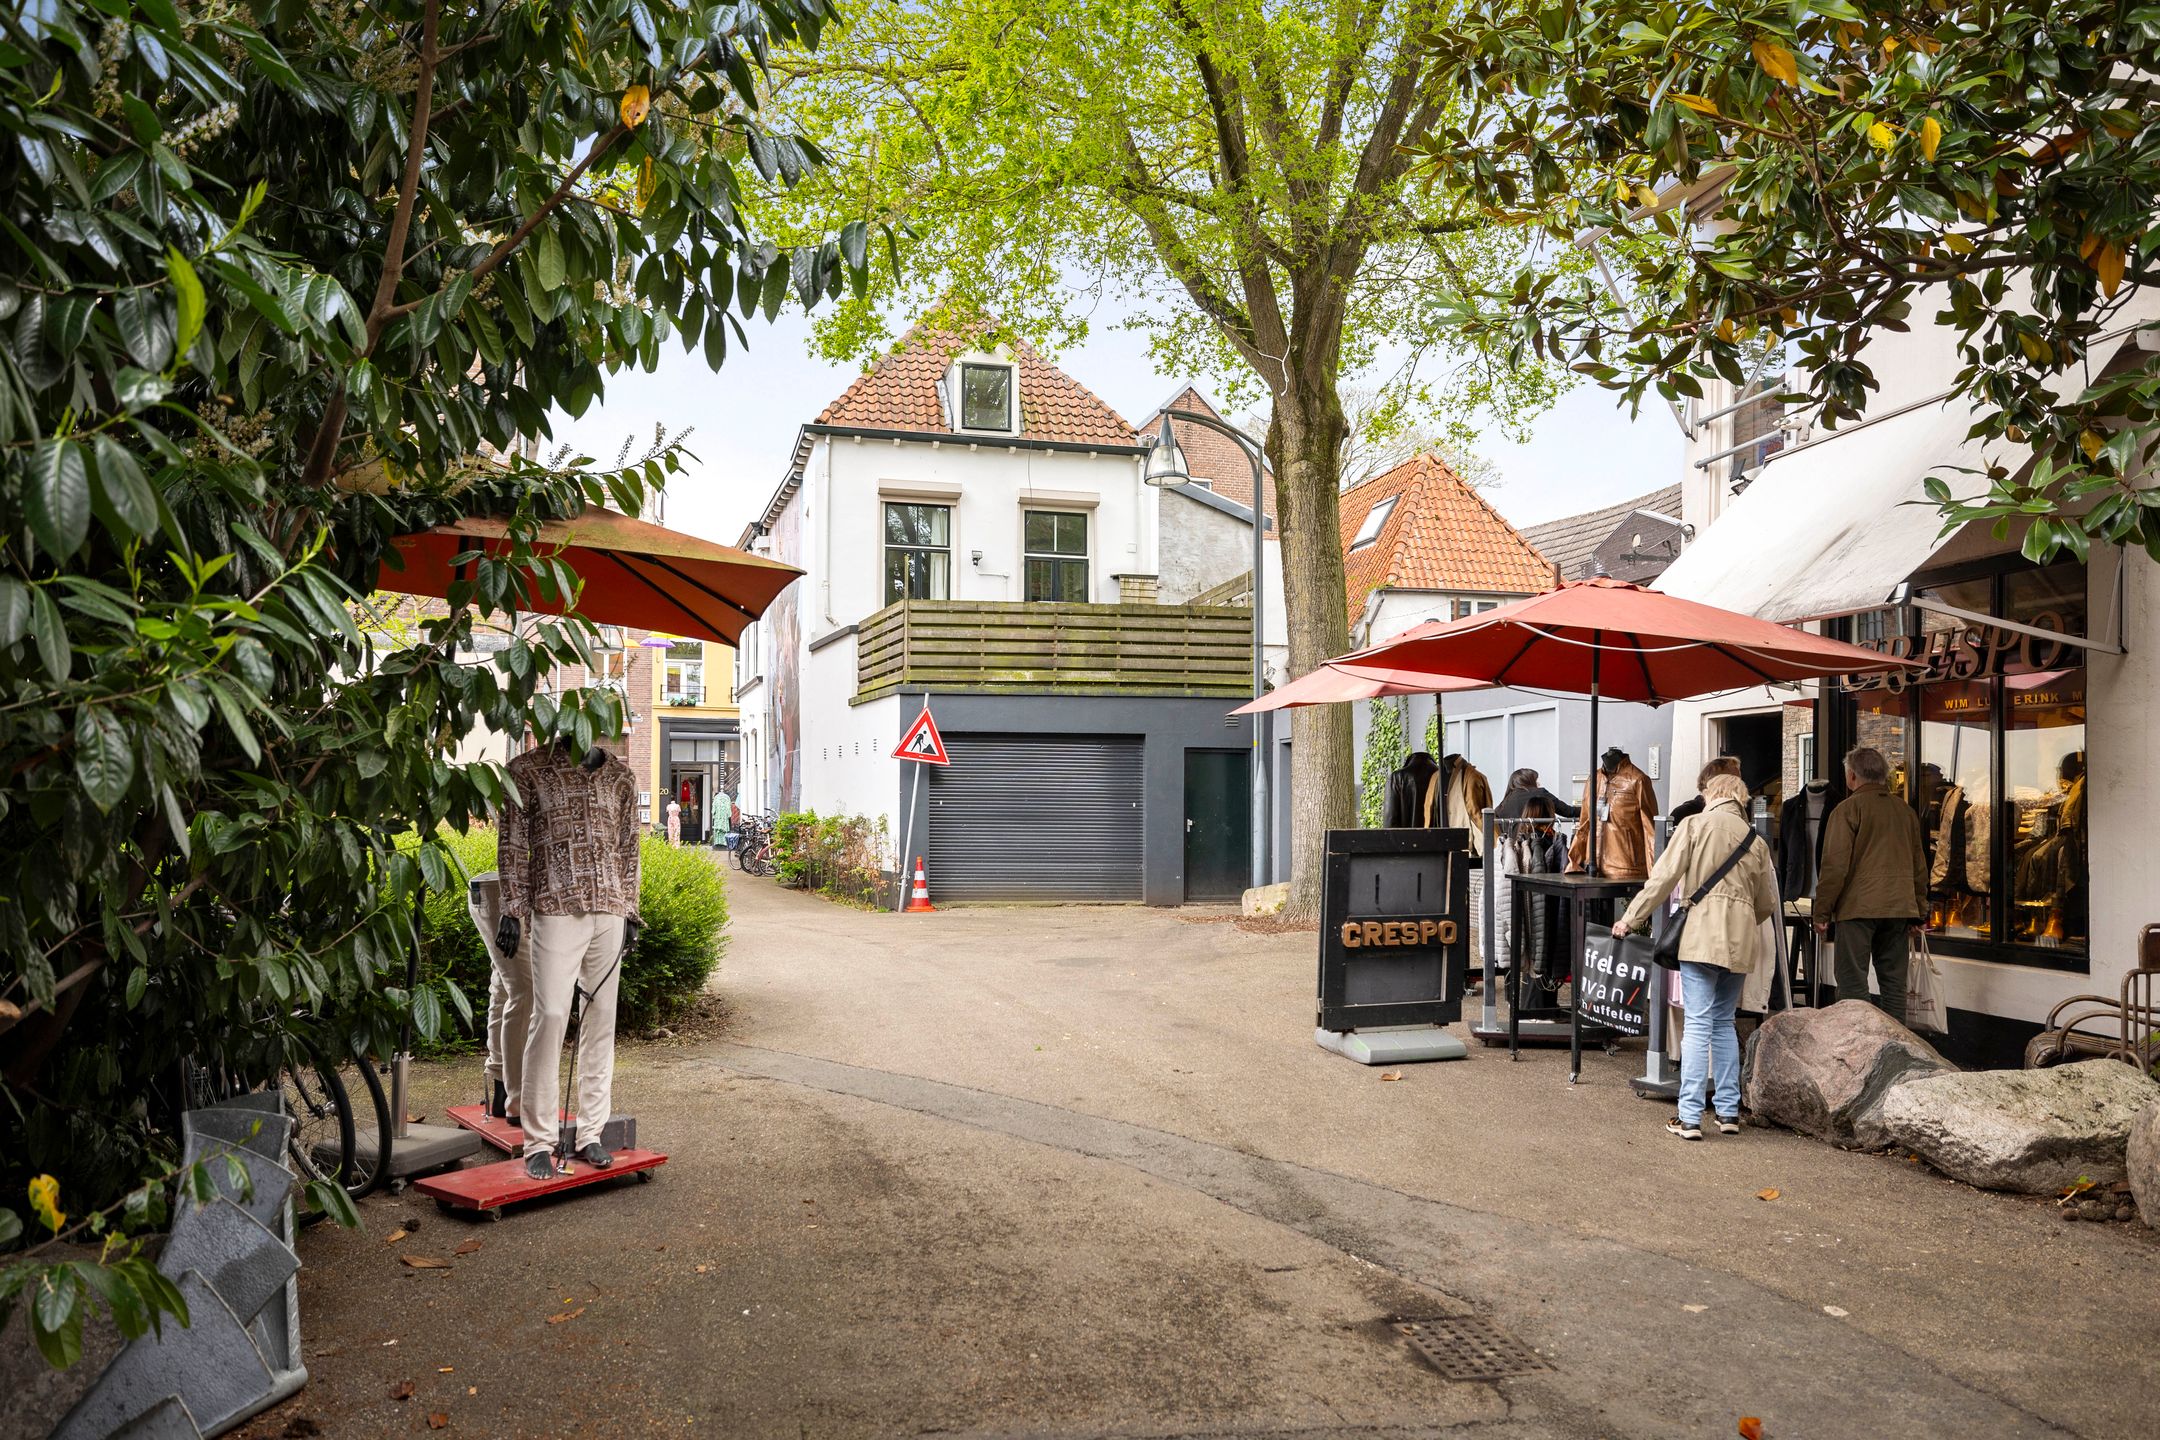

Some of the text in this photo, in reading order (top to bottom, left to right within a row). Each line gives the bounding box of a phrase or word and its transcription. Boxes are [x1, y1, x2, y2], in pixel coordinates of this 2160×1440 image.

[1945, 699, 1968, 710] WIM
[660, 787, 669, 796] 20
[1341, 920, 1458, 948] CRESPO
